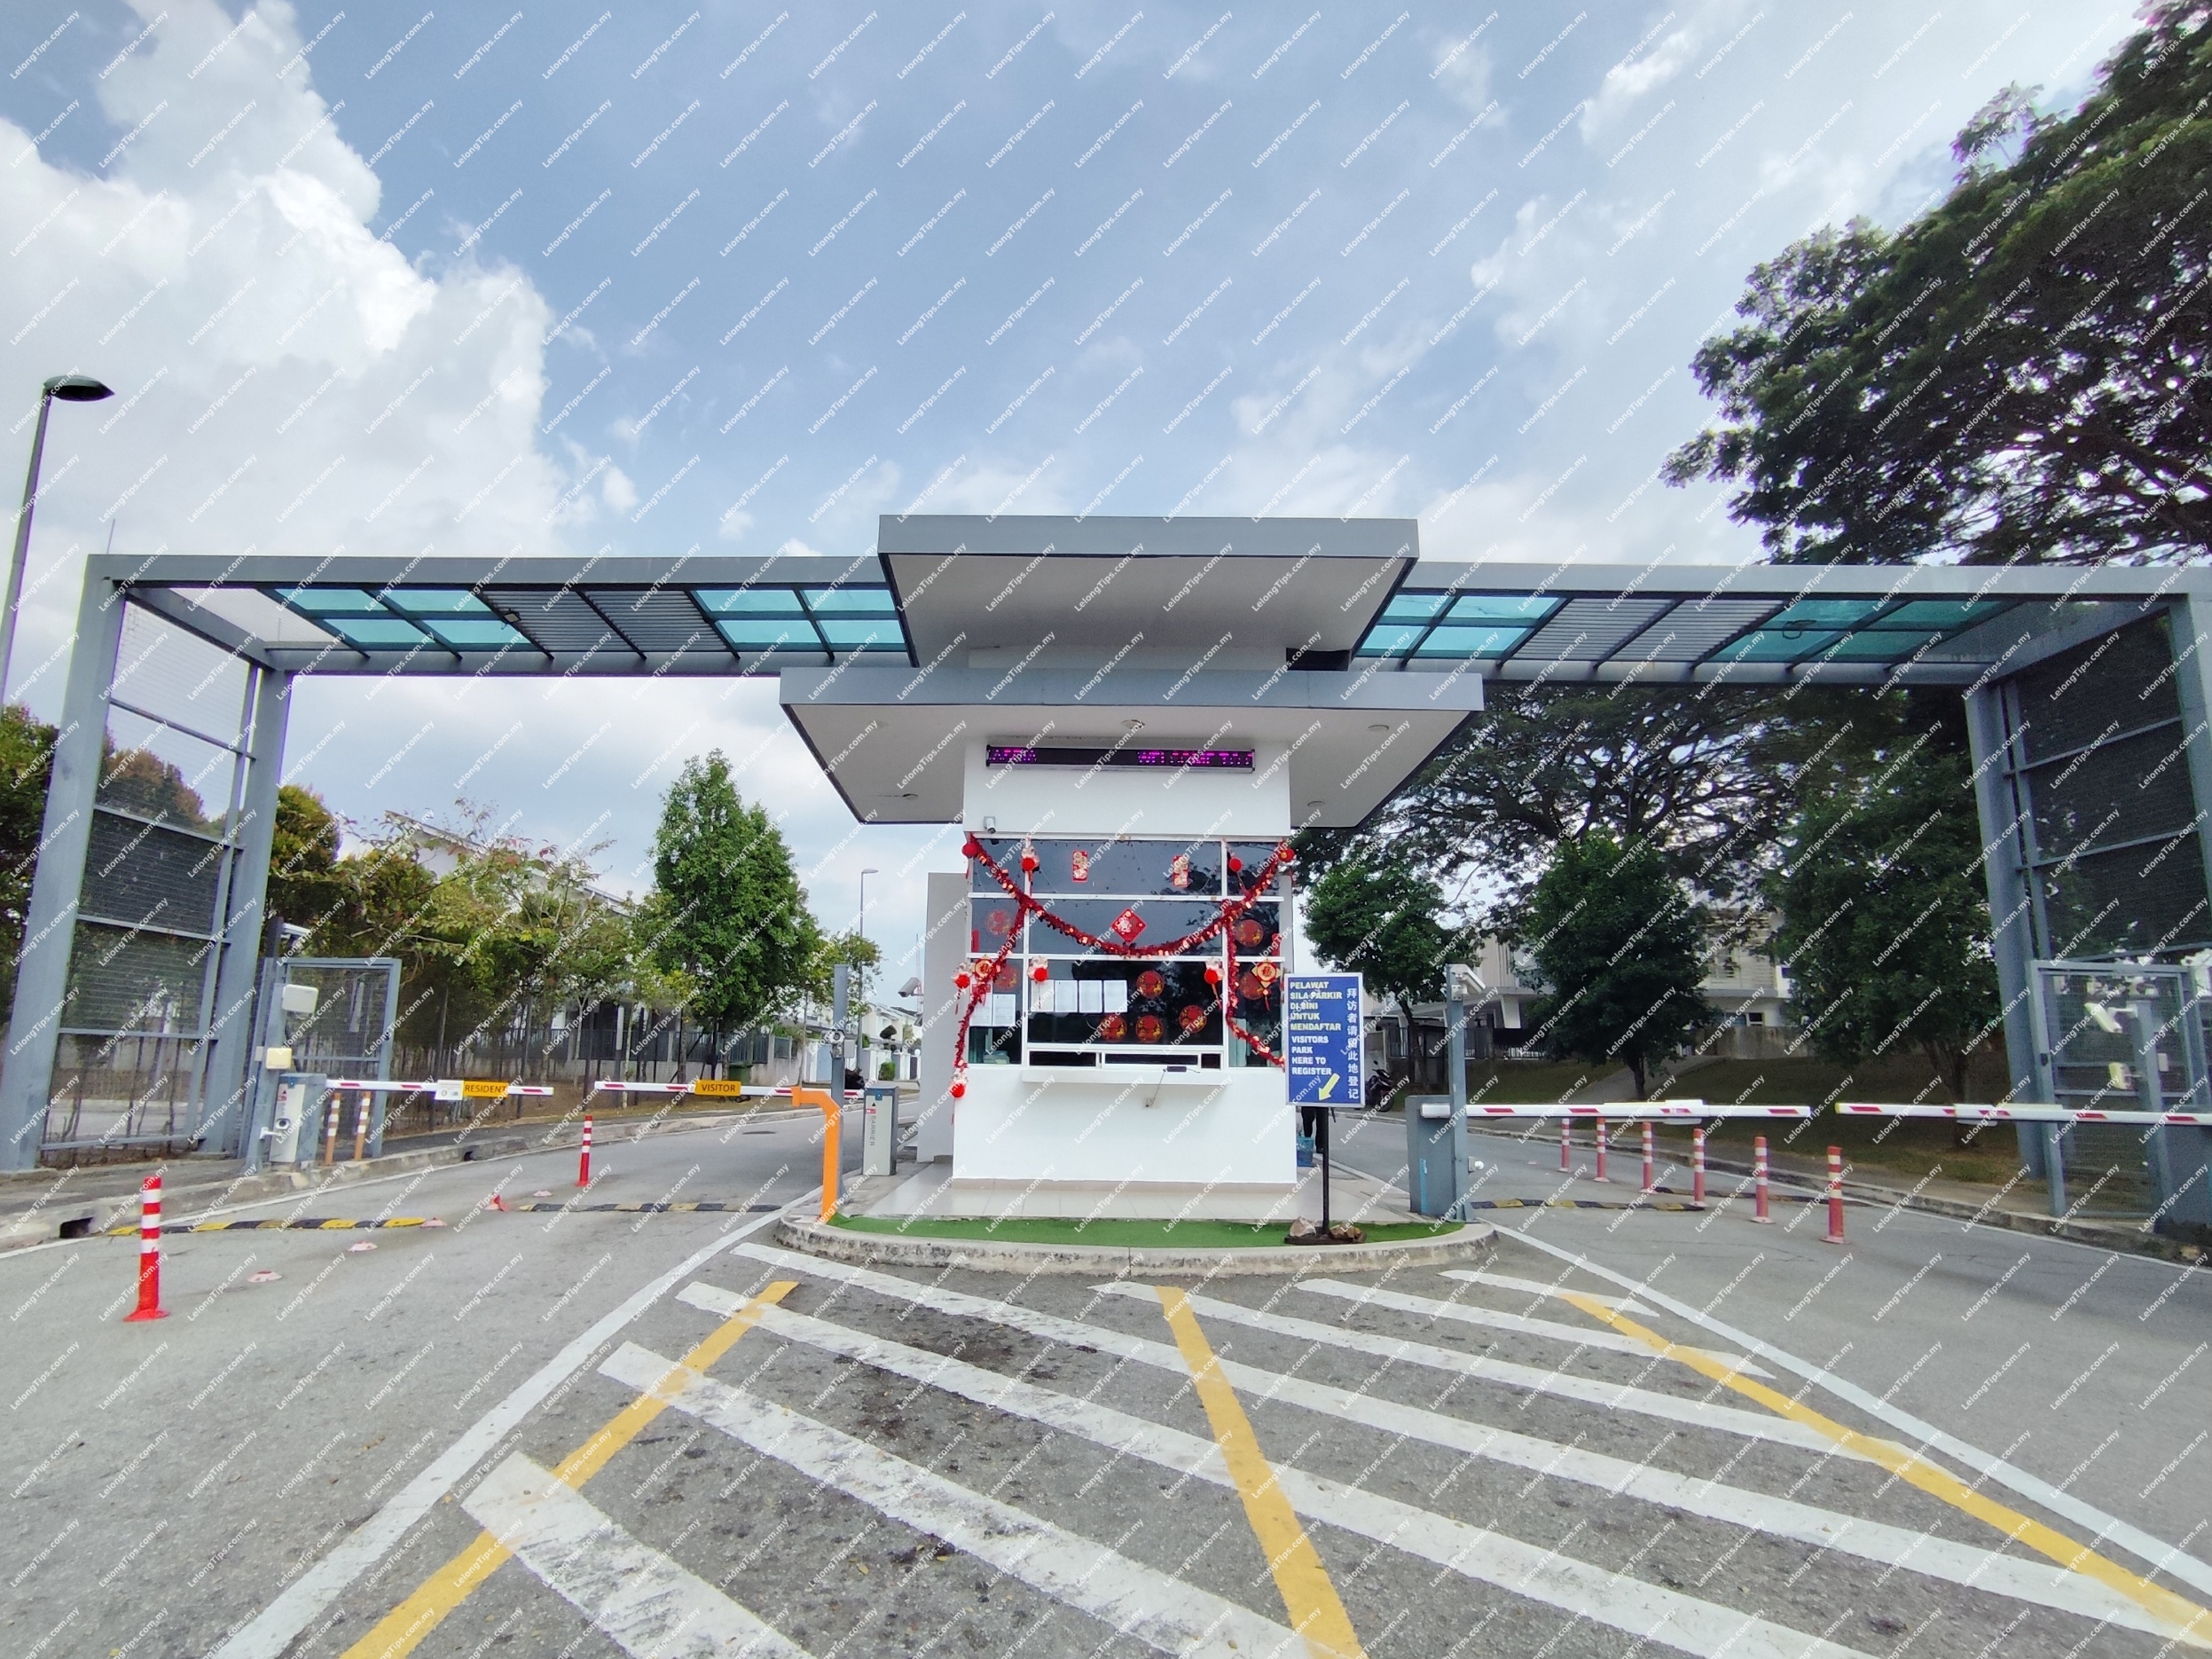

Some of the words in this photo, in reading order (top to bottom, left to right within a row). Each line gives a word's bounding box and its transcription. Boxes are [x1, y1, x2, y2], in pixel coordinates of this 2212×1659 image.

[1290, 981, 1329, 990] PELAWAT
[1290, 1002, 1299, 1010] DI
[1300, 1002, 1319, 1010] SINI
[1290, 1012, 1321, 1021] UNTUK
[1290, 1023, 1342, 1032] MENDAFTAR
[1291, 1035, 1329, 1044] VISITORS
[1291, 1066, 1332, 1075] REGISTER
[465, 1084, 506, 1093] RESIDENT
[702, 1083, 736, 1092] VISITOR
